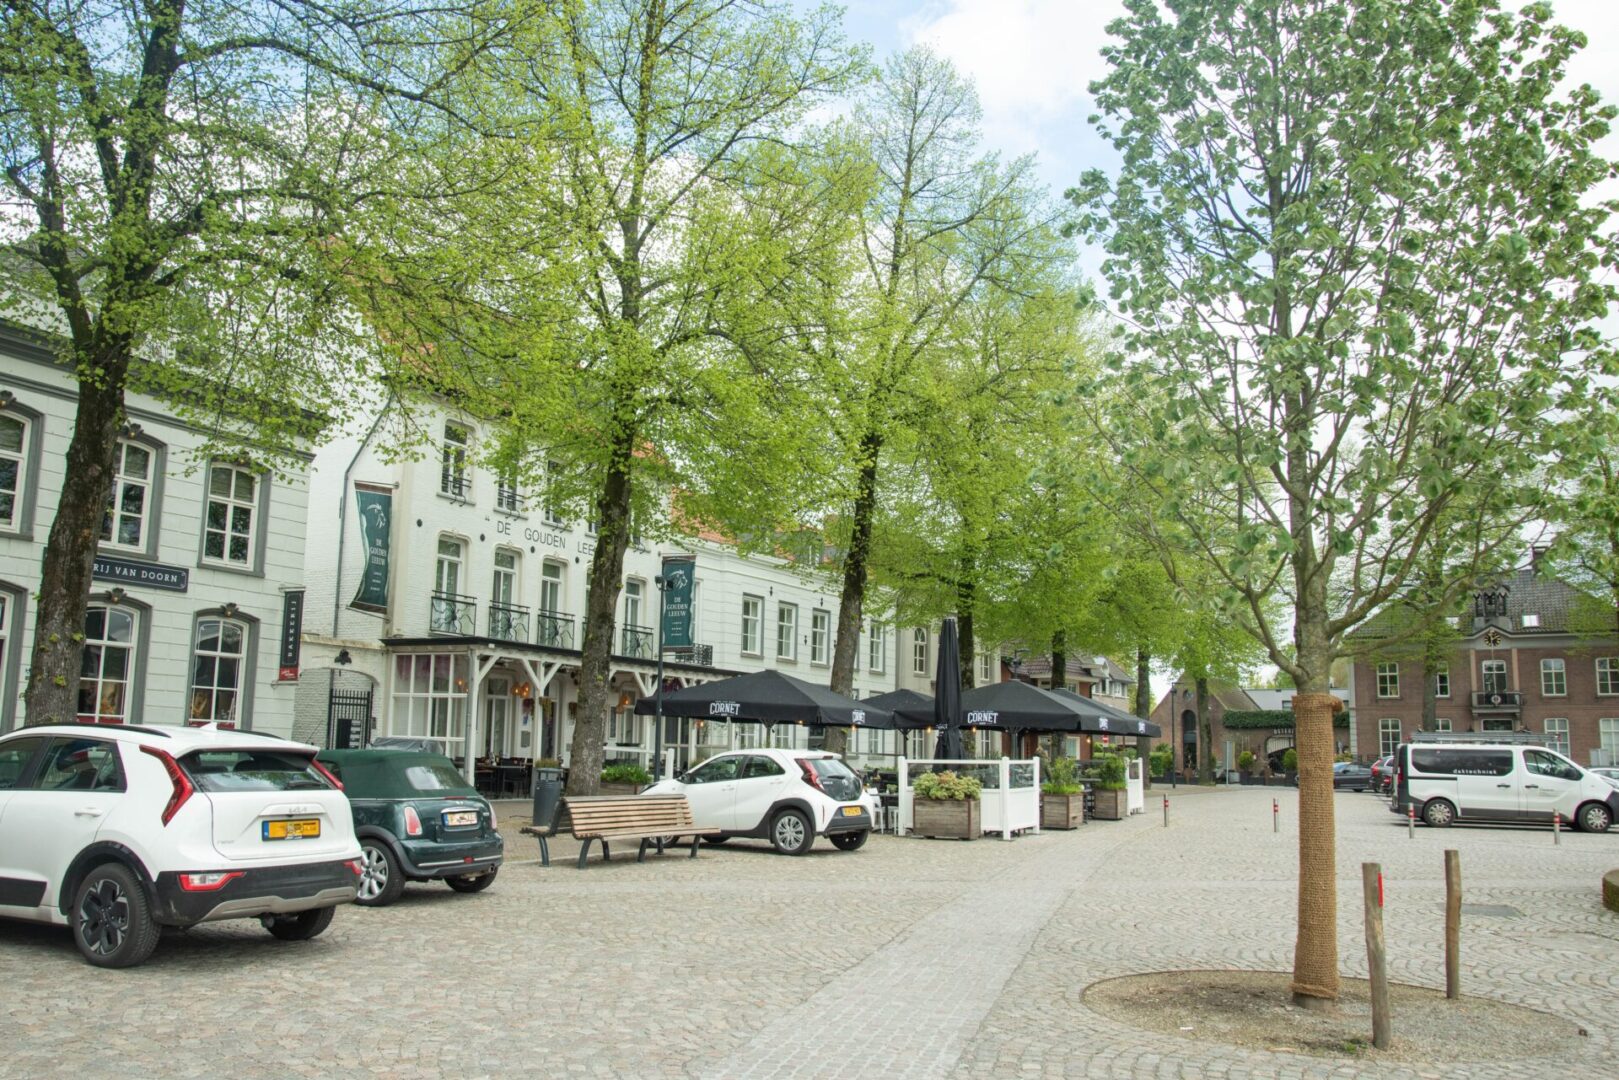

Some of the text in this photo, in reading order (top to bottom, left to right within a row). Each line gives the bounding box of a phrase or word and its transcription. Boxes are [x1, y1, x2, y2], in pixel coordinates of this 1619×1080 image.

[525, 528, 566, 549] GOUDEN
[578, 541, 595, 556] LEE
[93, 563, 178, 582] RIJ VAN DOORN
[288, 601, 297, 657] BAKKERIJ
[709, 702, 741, 716] CORNET
[967, 712, 999, 724] CORNET
